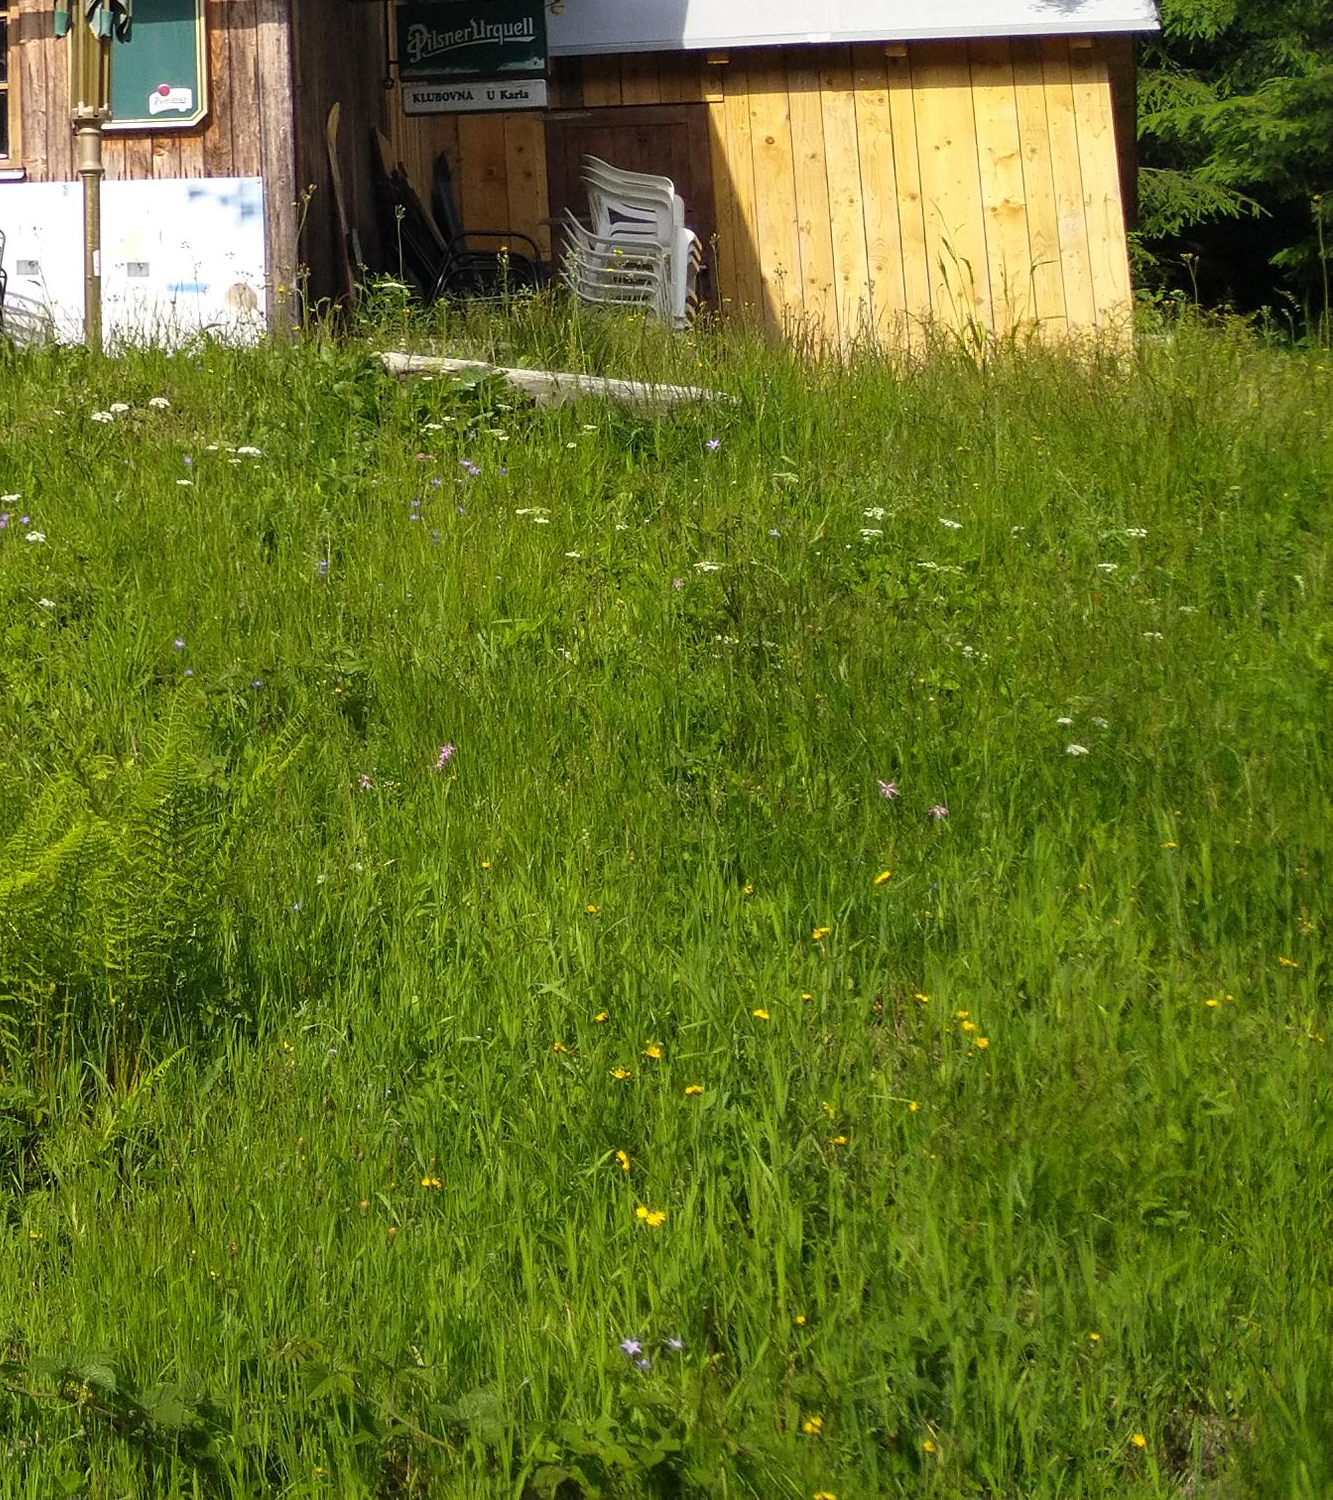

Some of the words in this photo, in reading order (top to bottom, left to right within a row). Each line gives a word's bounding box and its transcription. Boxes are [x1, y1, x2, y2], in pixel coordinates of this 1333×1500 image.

[406, 22, 474, 64] Pilsner
[468, 16, 536, 45] Urquell
[486, 90, 496, 101] U
